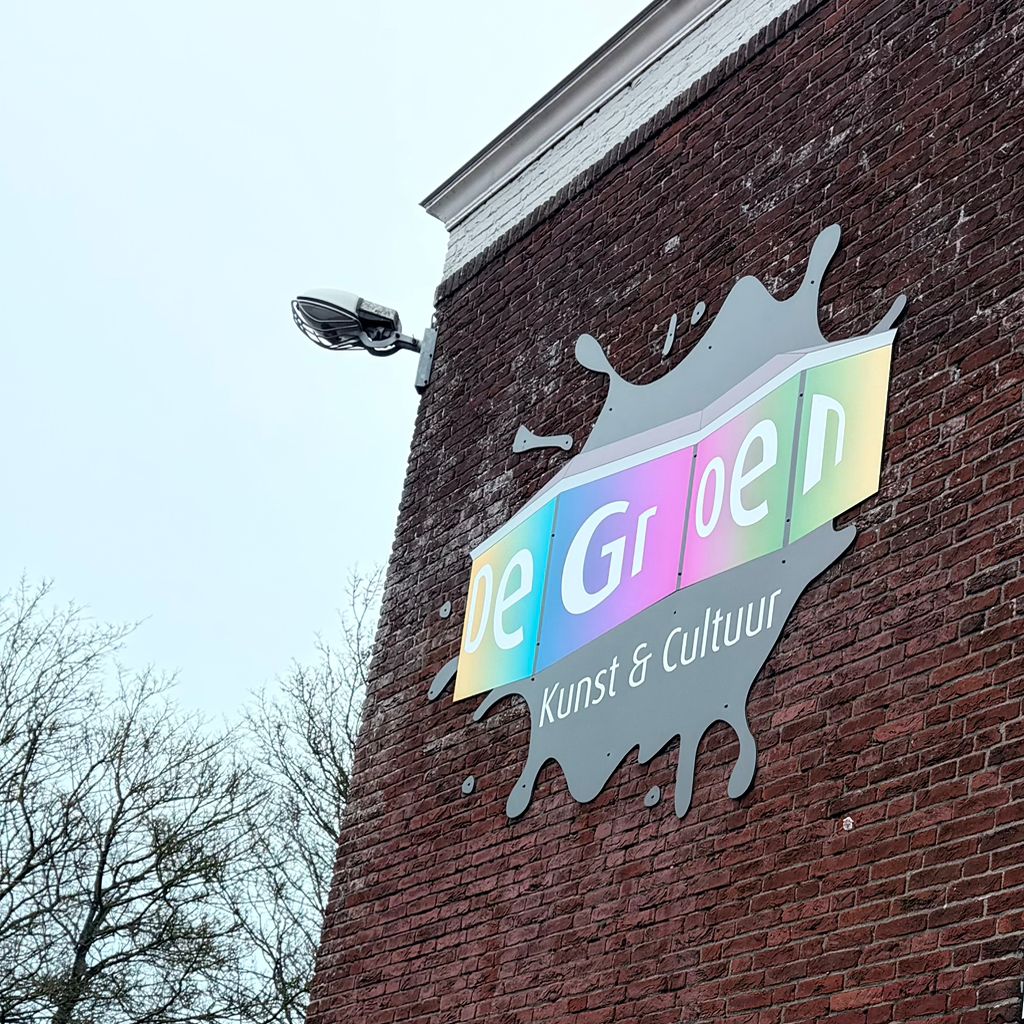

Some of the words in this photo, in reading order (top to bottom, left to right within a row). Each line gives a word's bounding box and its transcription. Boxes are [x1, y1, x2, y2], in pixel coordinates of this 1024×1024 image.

[464, 547, 534, 654] De
[561, 393, 846, 616] Groen
[538, 655, 620, 729] Kunst
[628, 643, 653, 686] &
[662, 588, 782, 672] Cultuur
